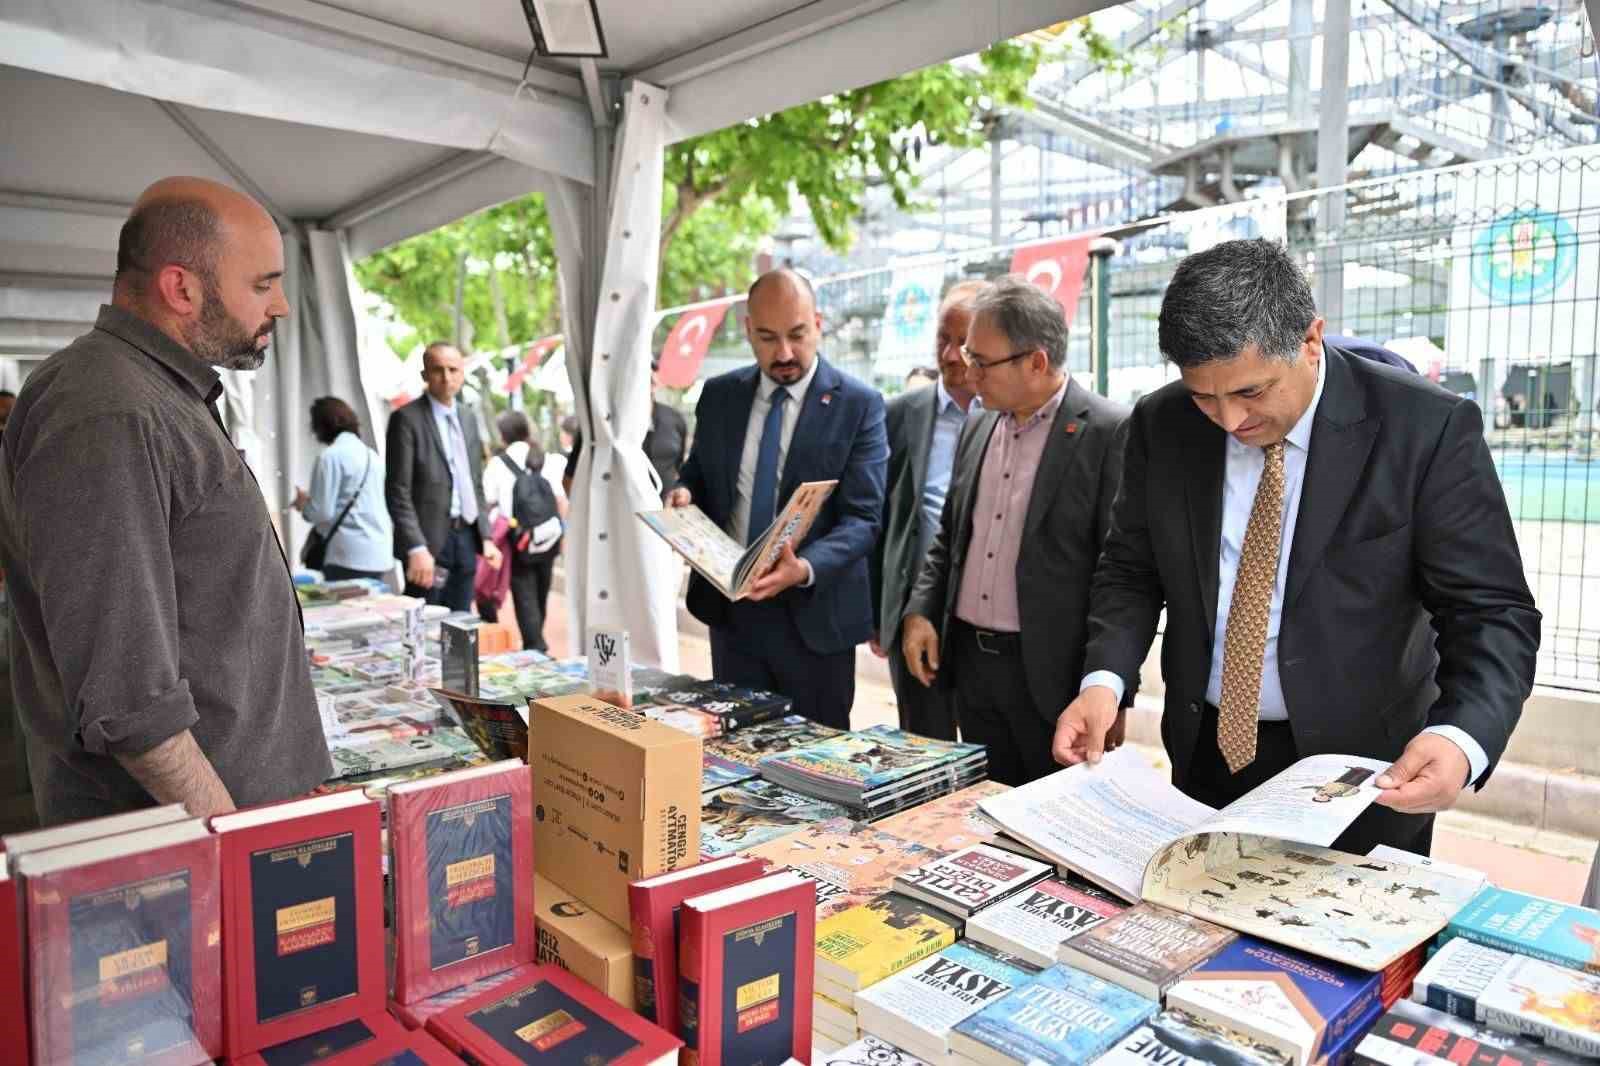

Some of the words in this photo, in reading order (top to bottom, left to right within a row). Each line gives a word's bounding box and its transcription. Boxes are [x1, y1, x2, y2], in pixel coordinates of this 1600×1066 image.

[677, 814, 687, 859] CENGİZ
[1021, 890, 1103, 927] ASYA
[917, 958, 1010, 1000] ASYA
